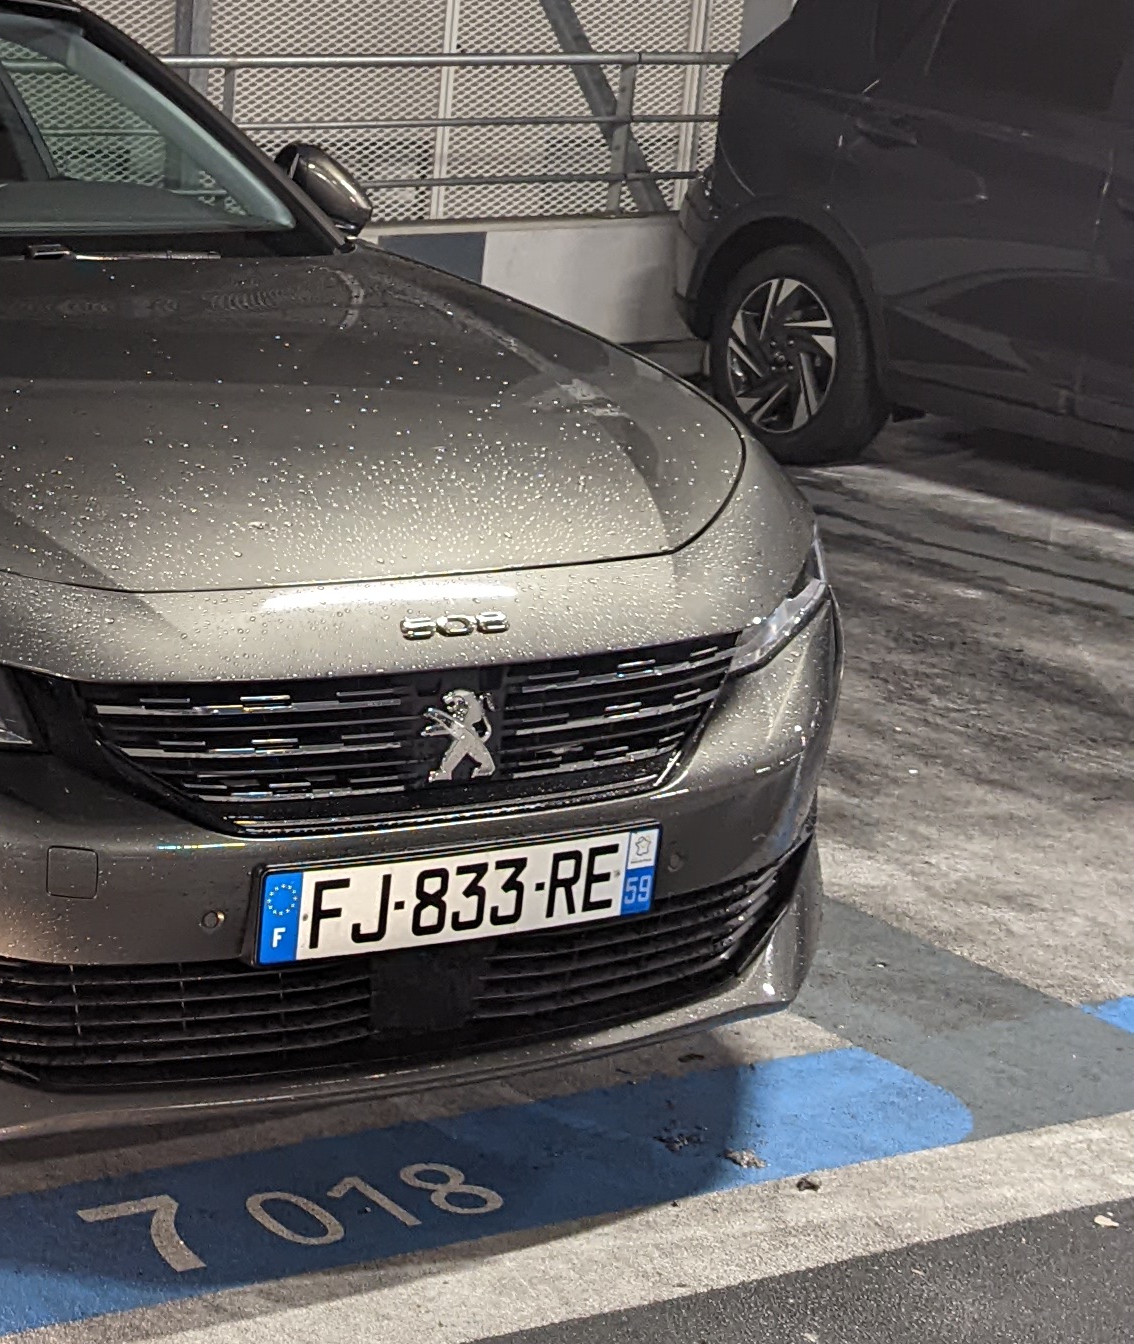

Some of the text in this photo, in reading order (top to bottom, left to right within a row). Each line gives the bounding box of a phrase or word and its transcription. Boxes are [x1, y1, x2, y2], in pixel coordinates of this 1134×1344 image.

[399, 611, 510, 641] 508
[308, 843, 620, 950] FJ-833-RE
[623, 874, 652, 905] 59
[271, 926, 287, 948] F
[76, 1162, 504, 1273] 7 018
